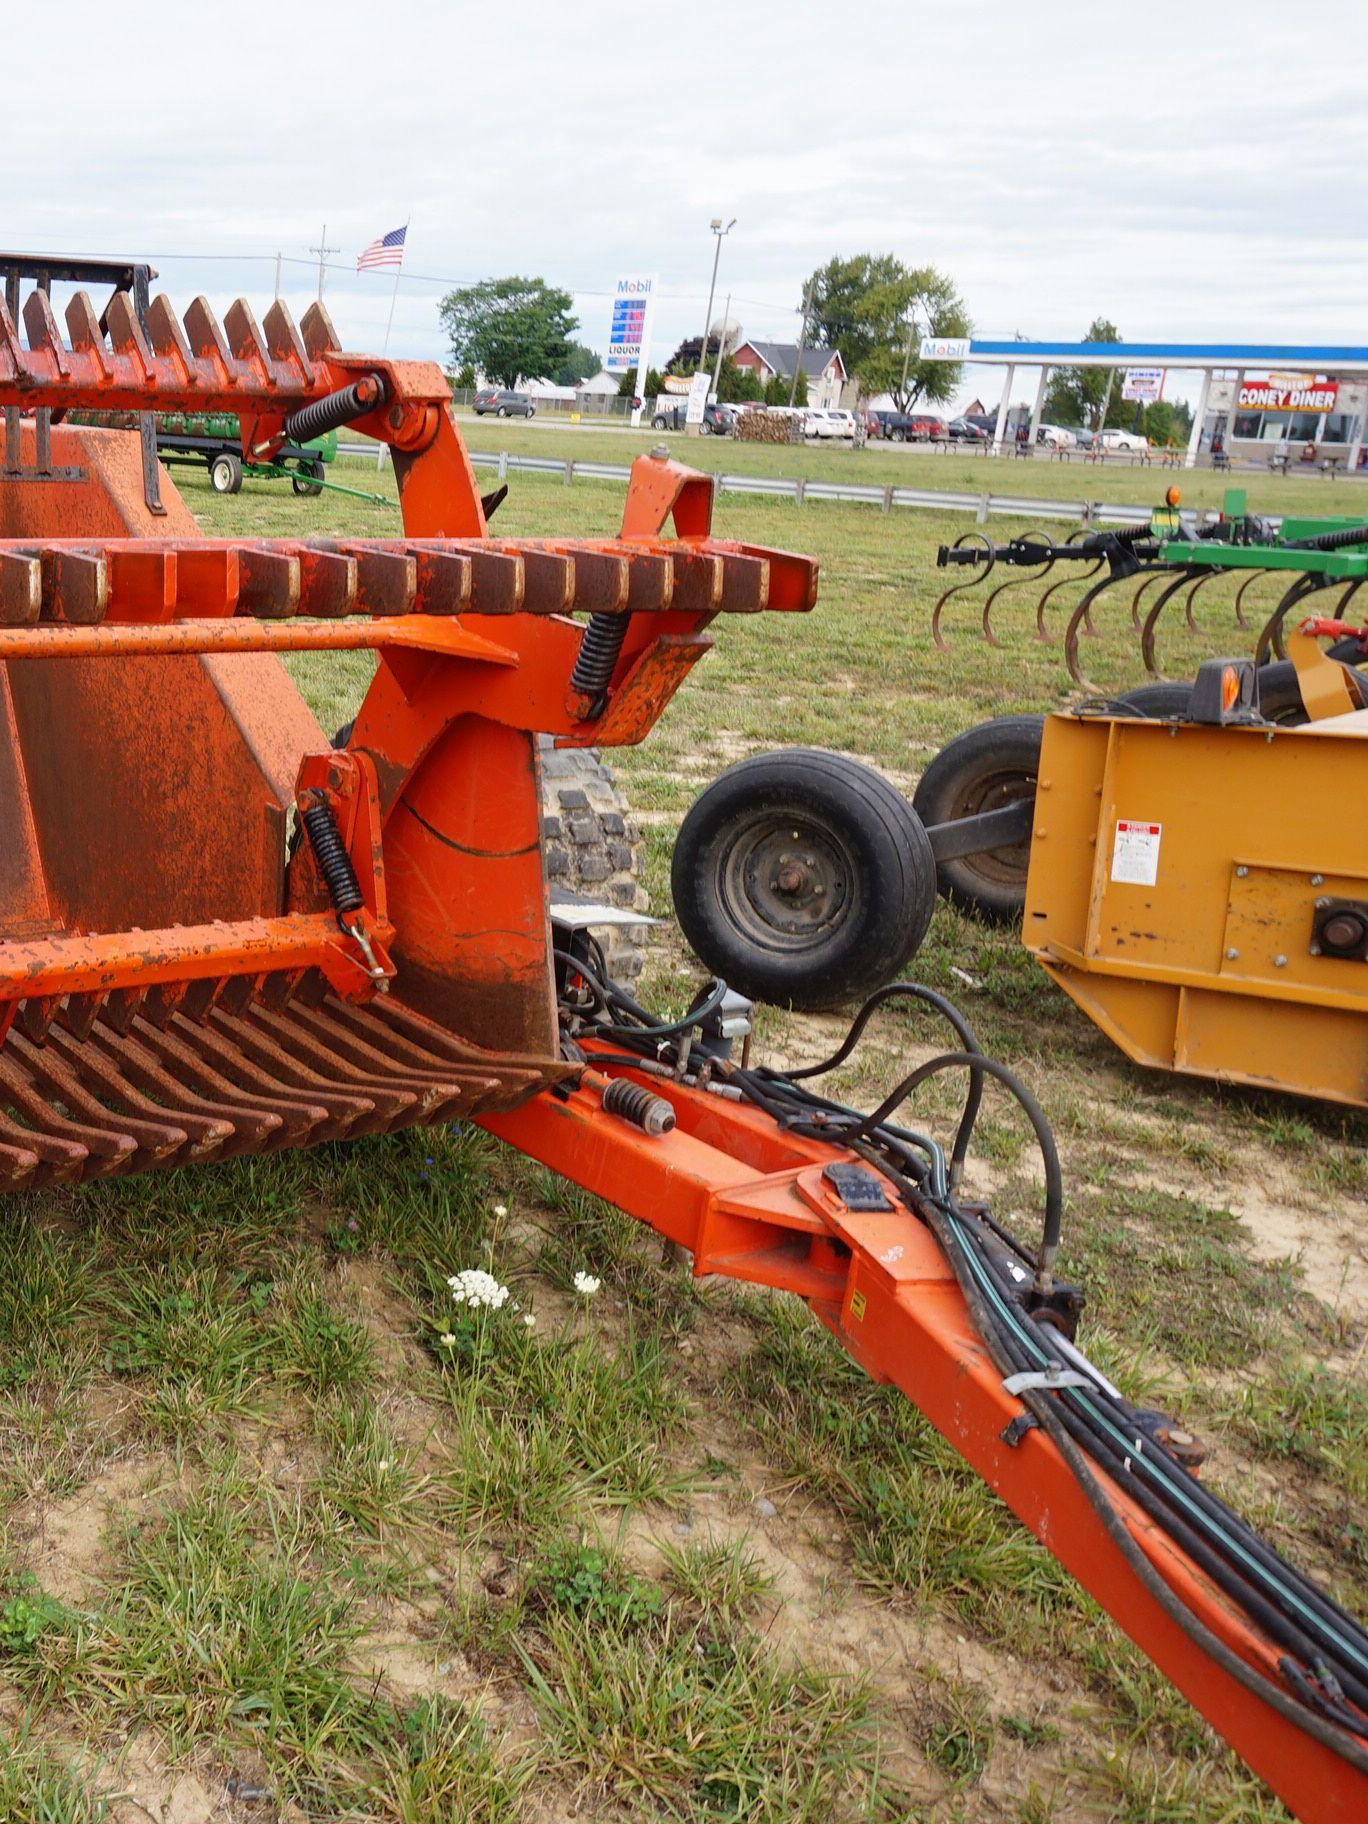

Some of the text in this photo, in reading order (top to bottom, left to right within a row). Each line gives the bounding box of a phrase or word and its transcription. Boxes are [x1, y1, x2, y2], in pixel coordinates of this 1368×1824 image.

[617, 279, 652, 294] Mobil
[609, 345, 640, 355] LIQUOR
[924, 342, 965, 357] Mobil
[1238, 387, 1336, 408] CONEY DINER
